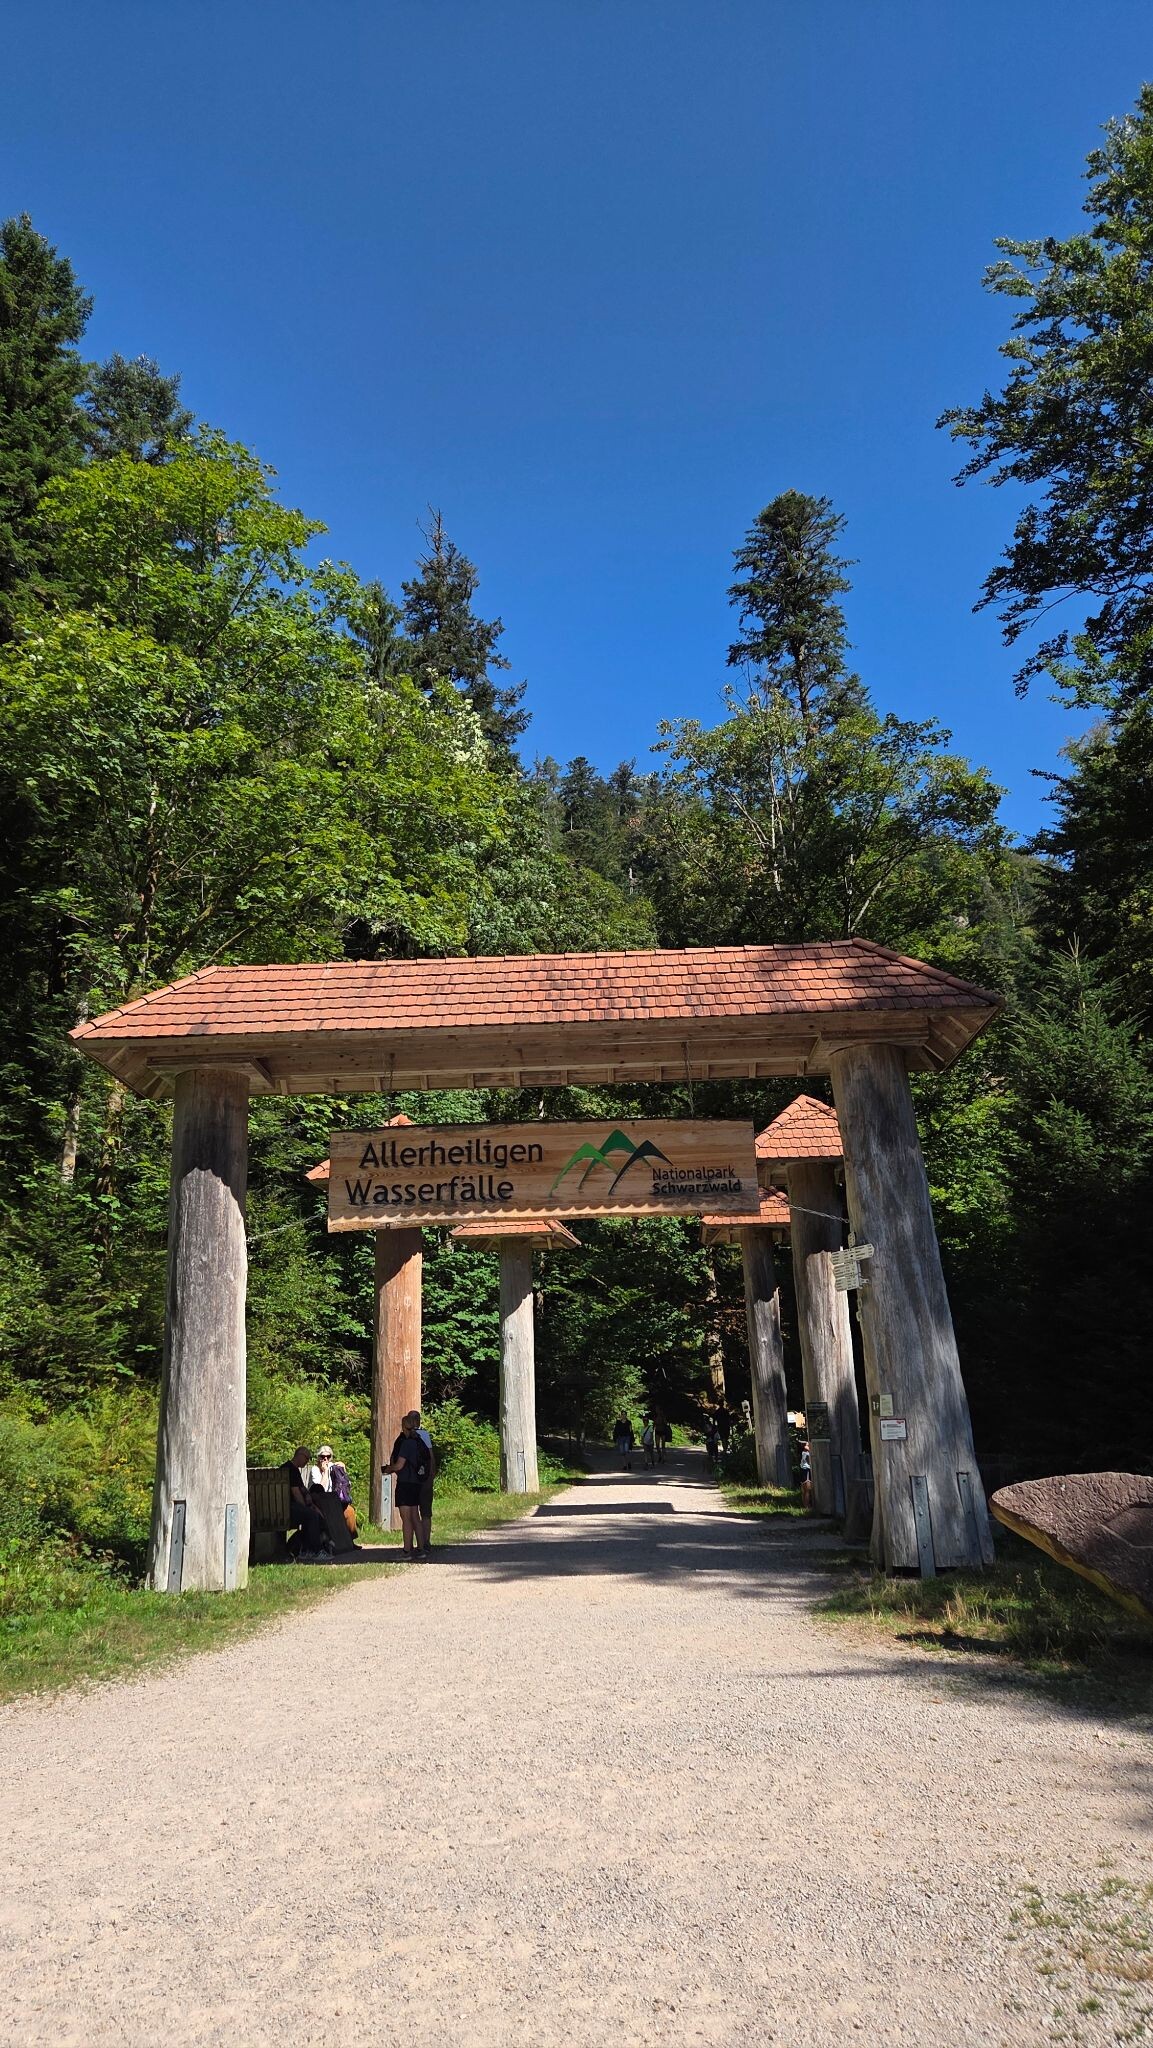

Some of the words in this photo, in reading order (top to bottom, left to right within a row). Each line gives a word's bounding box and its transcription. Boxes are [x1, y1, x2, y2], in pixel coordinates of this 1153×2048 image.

[359, 1139, 543, 1168] Allerheiligen
[652, 1165, 735, 1181] Nationalpark
[344, 1175, 514, 1205] Wasserfälle
[652, 1180, 741, 1194] Schwarzwald
